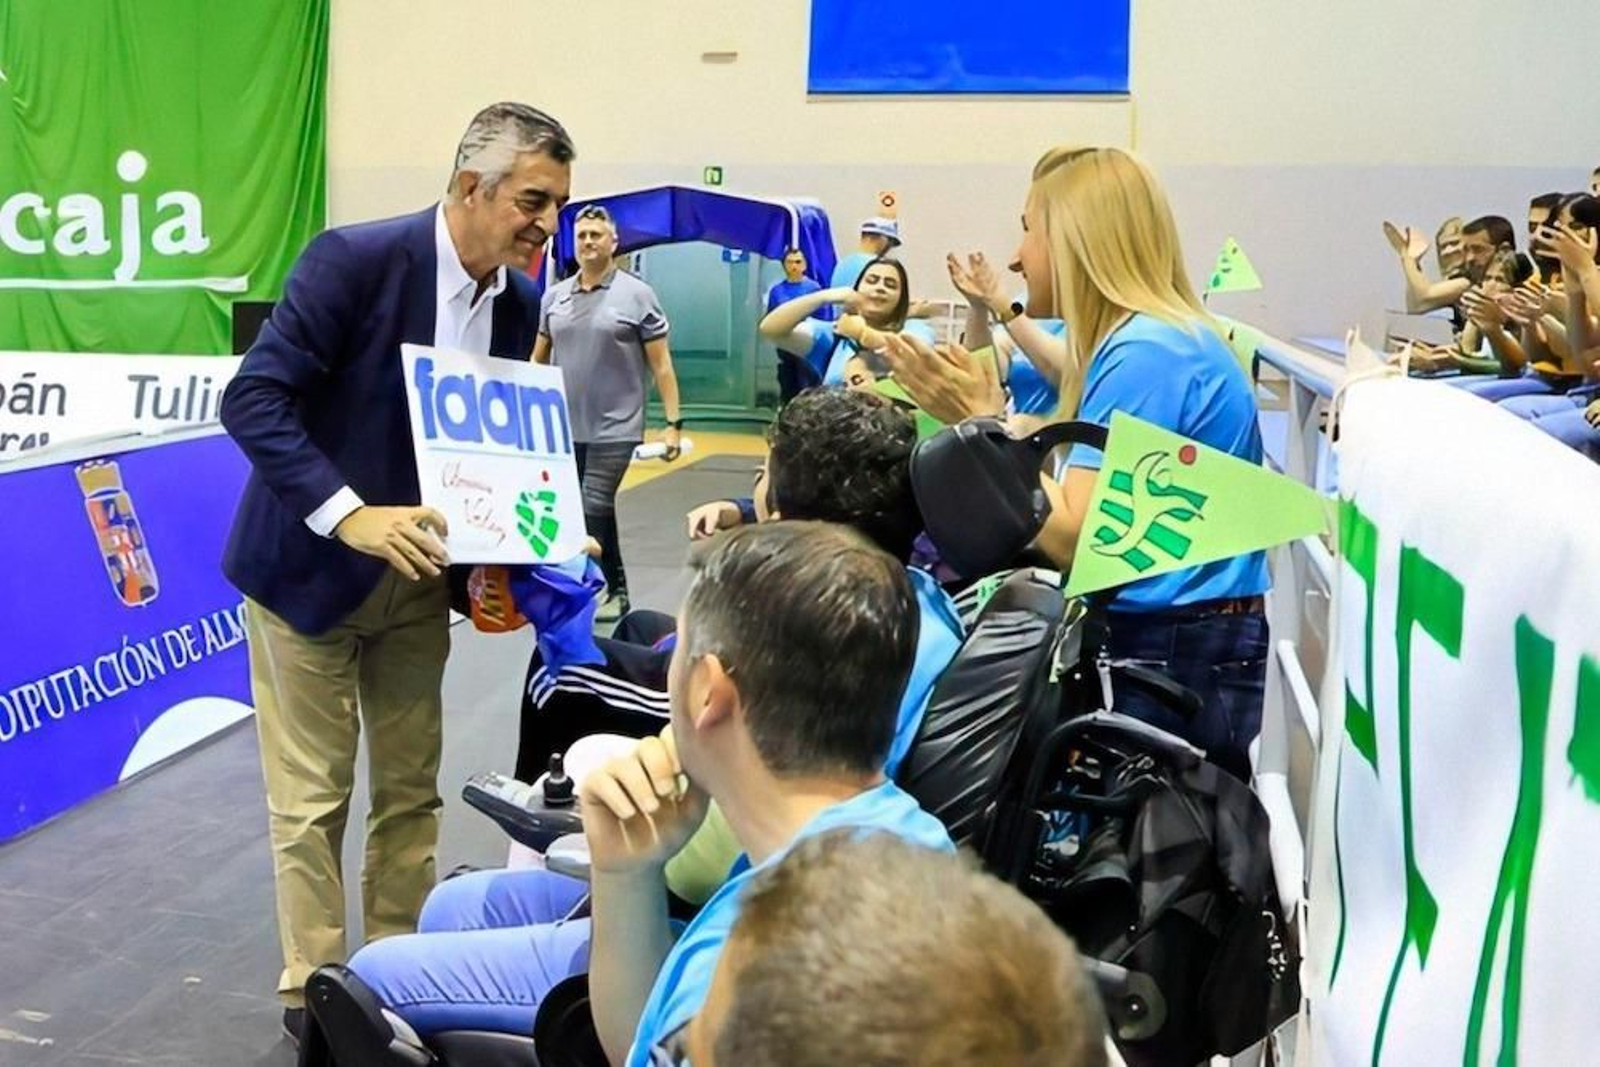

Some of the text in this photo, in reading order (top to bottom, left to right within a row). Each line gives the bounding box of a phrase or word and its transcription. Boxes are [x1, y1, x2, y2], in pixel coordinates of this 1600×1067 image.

[0, 150, 210, 282] caja
[414, 357, 571, 454] faam
[0, 635, 166, 742] DIPUTACIÓN
[162, 624, 202, 669] DE
